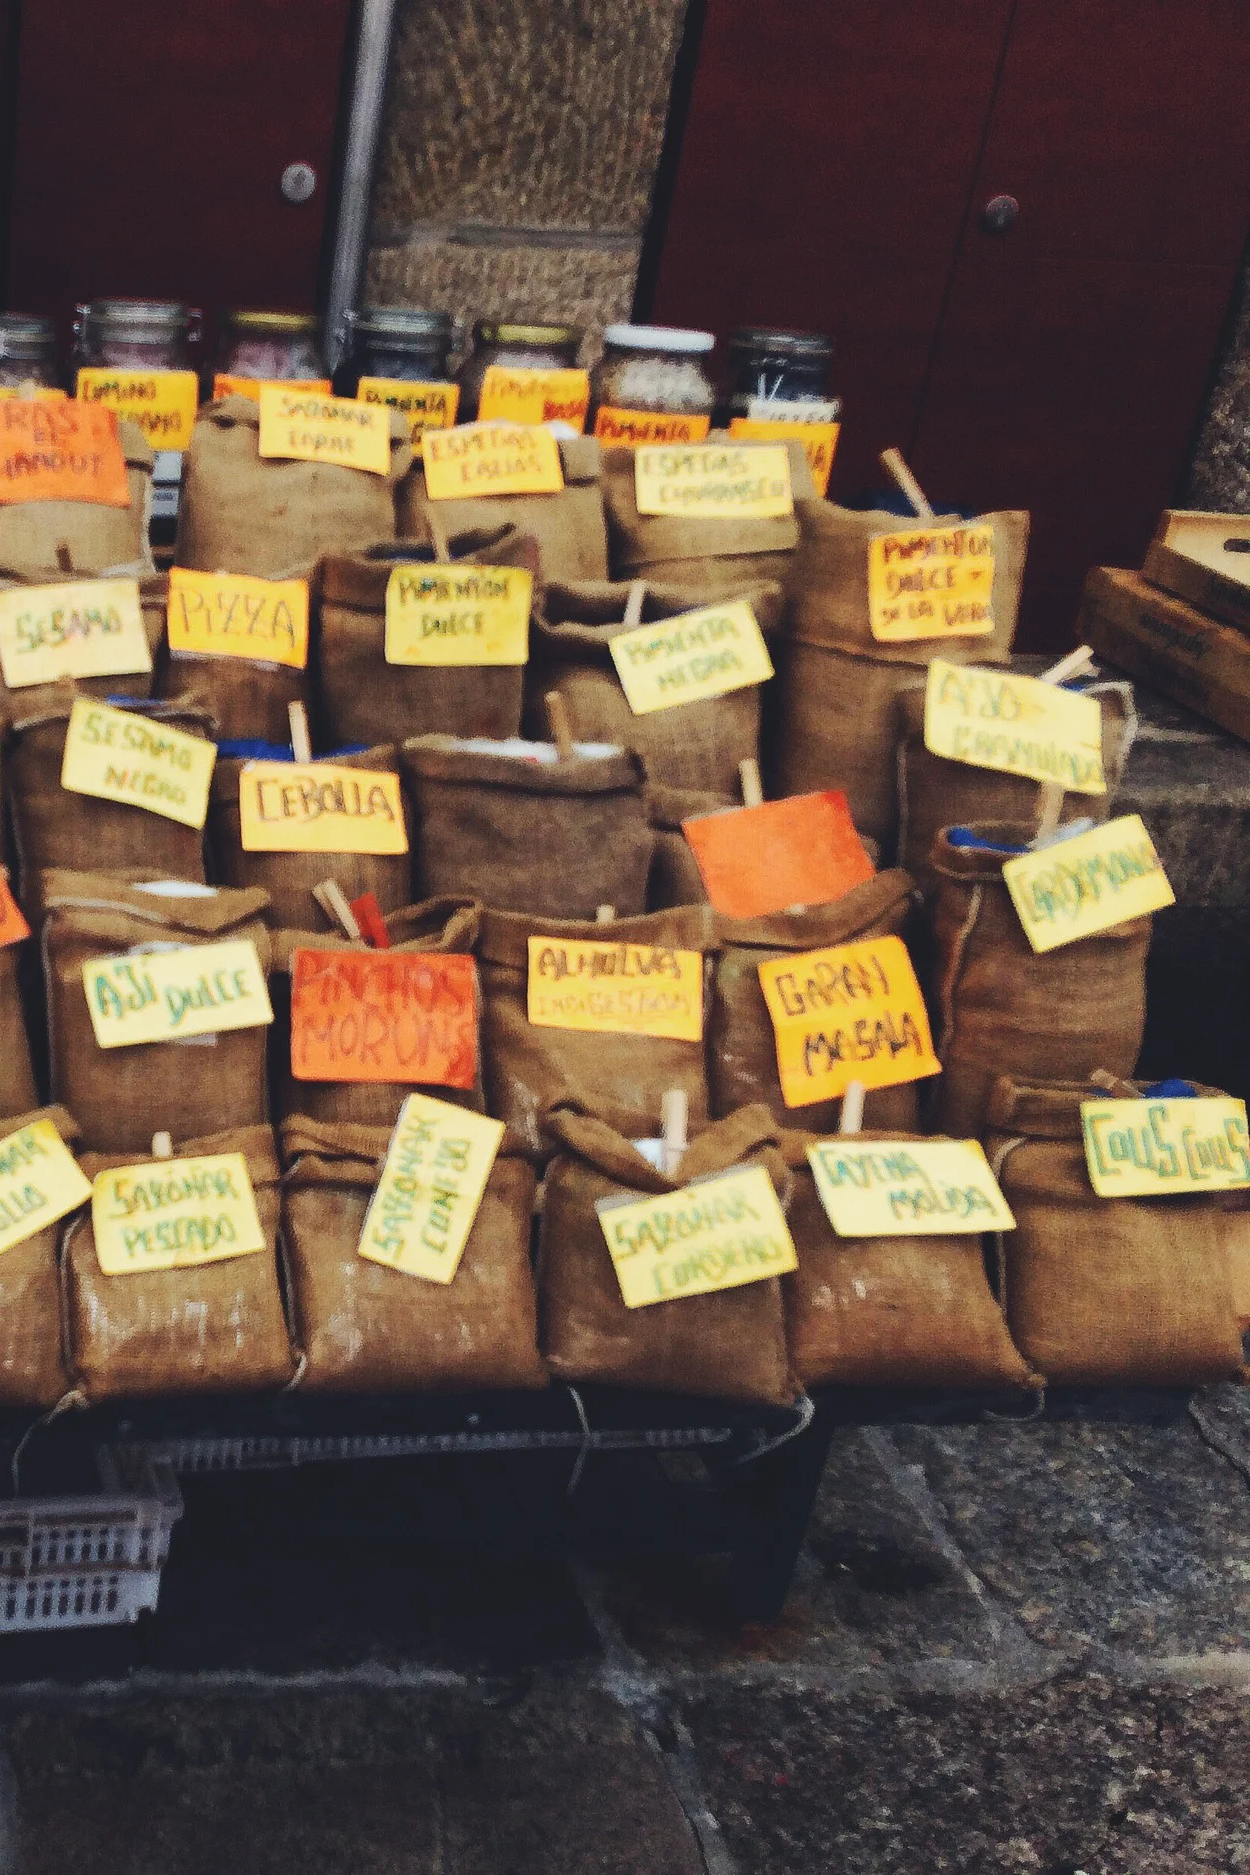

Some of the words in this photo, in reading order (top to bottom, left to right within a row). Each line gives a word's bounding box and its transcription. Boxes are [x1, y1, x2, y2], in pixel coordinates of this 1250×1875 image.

[177, 588, 296, 650] PIZZA
[421, 610, 486, 640] DULCE
[256, 773, 397, 825] CEBOLLA
[165, 966, 253, 1027] DULCE
[803, 1009, 924, 1078] MASALA
[1086, 1104, 1179, 1179] COUS
[120, 1212, 237, 1260] PESCADO
